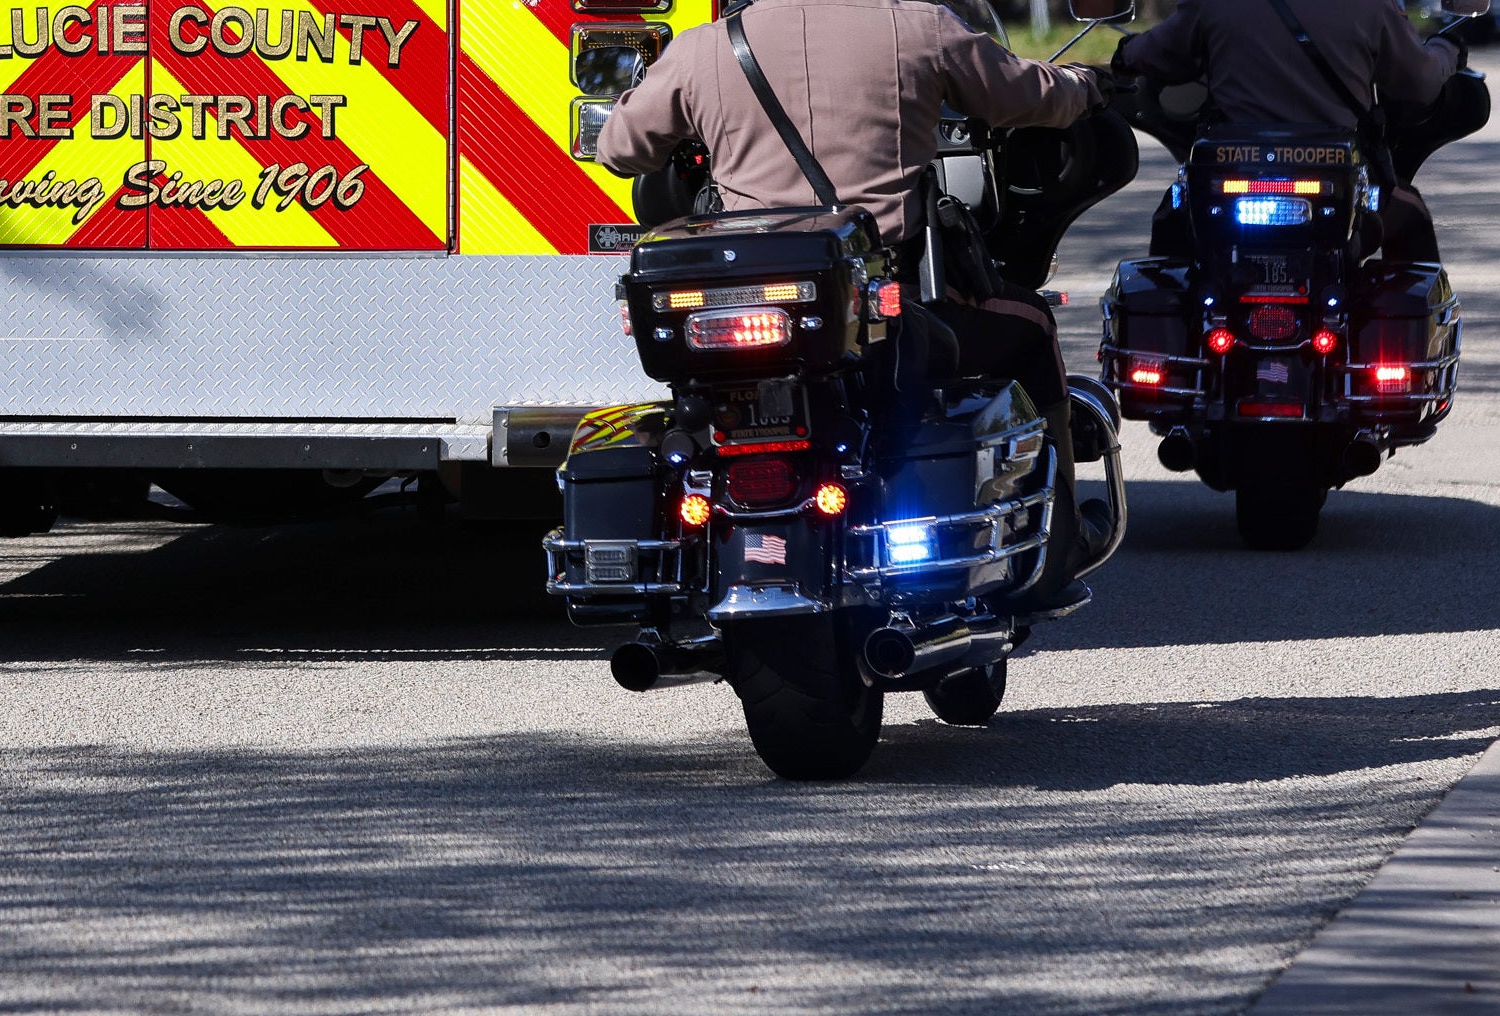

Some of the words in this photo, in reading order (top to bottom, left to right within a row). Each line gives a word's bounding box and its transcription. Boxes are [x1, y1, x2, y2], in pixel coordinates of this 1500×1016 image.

[168, 6, 420, 67] COUNTY
[89, 93, 348, 140] DISTRICT
[1216, 146, 1260, 162] STATE
[1274, 147, 1346, 164] TROOPER
[119, 159, 246, 212] Since
[254, 161, 370, 211] 1906
